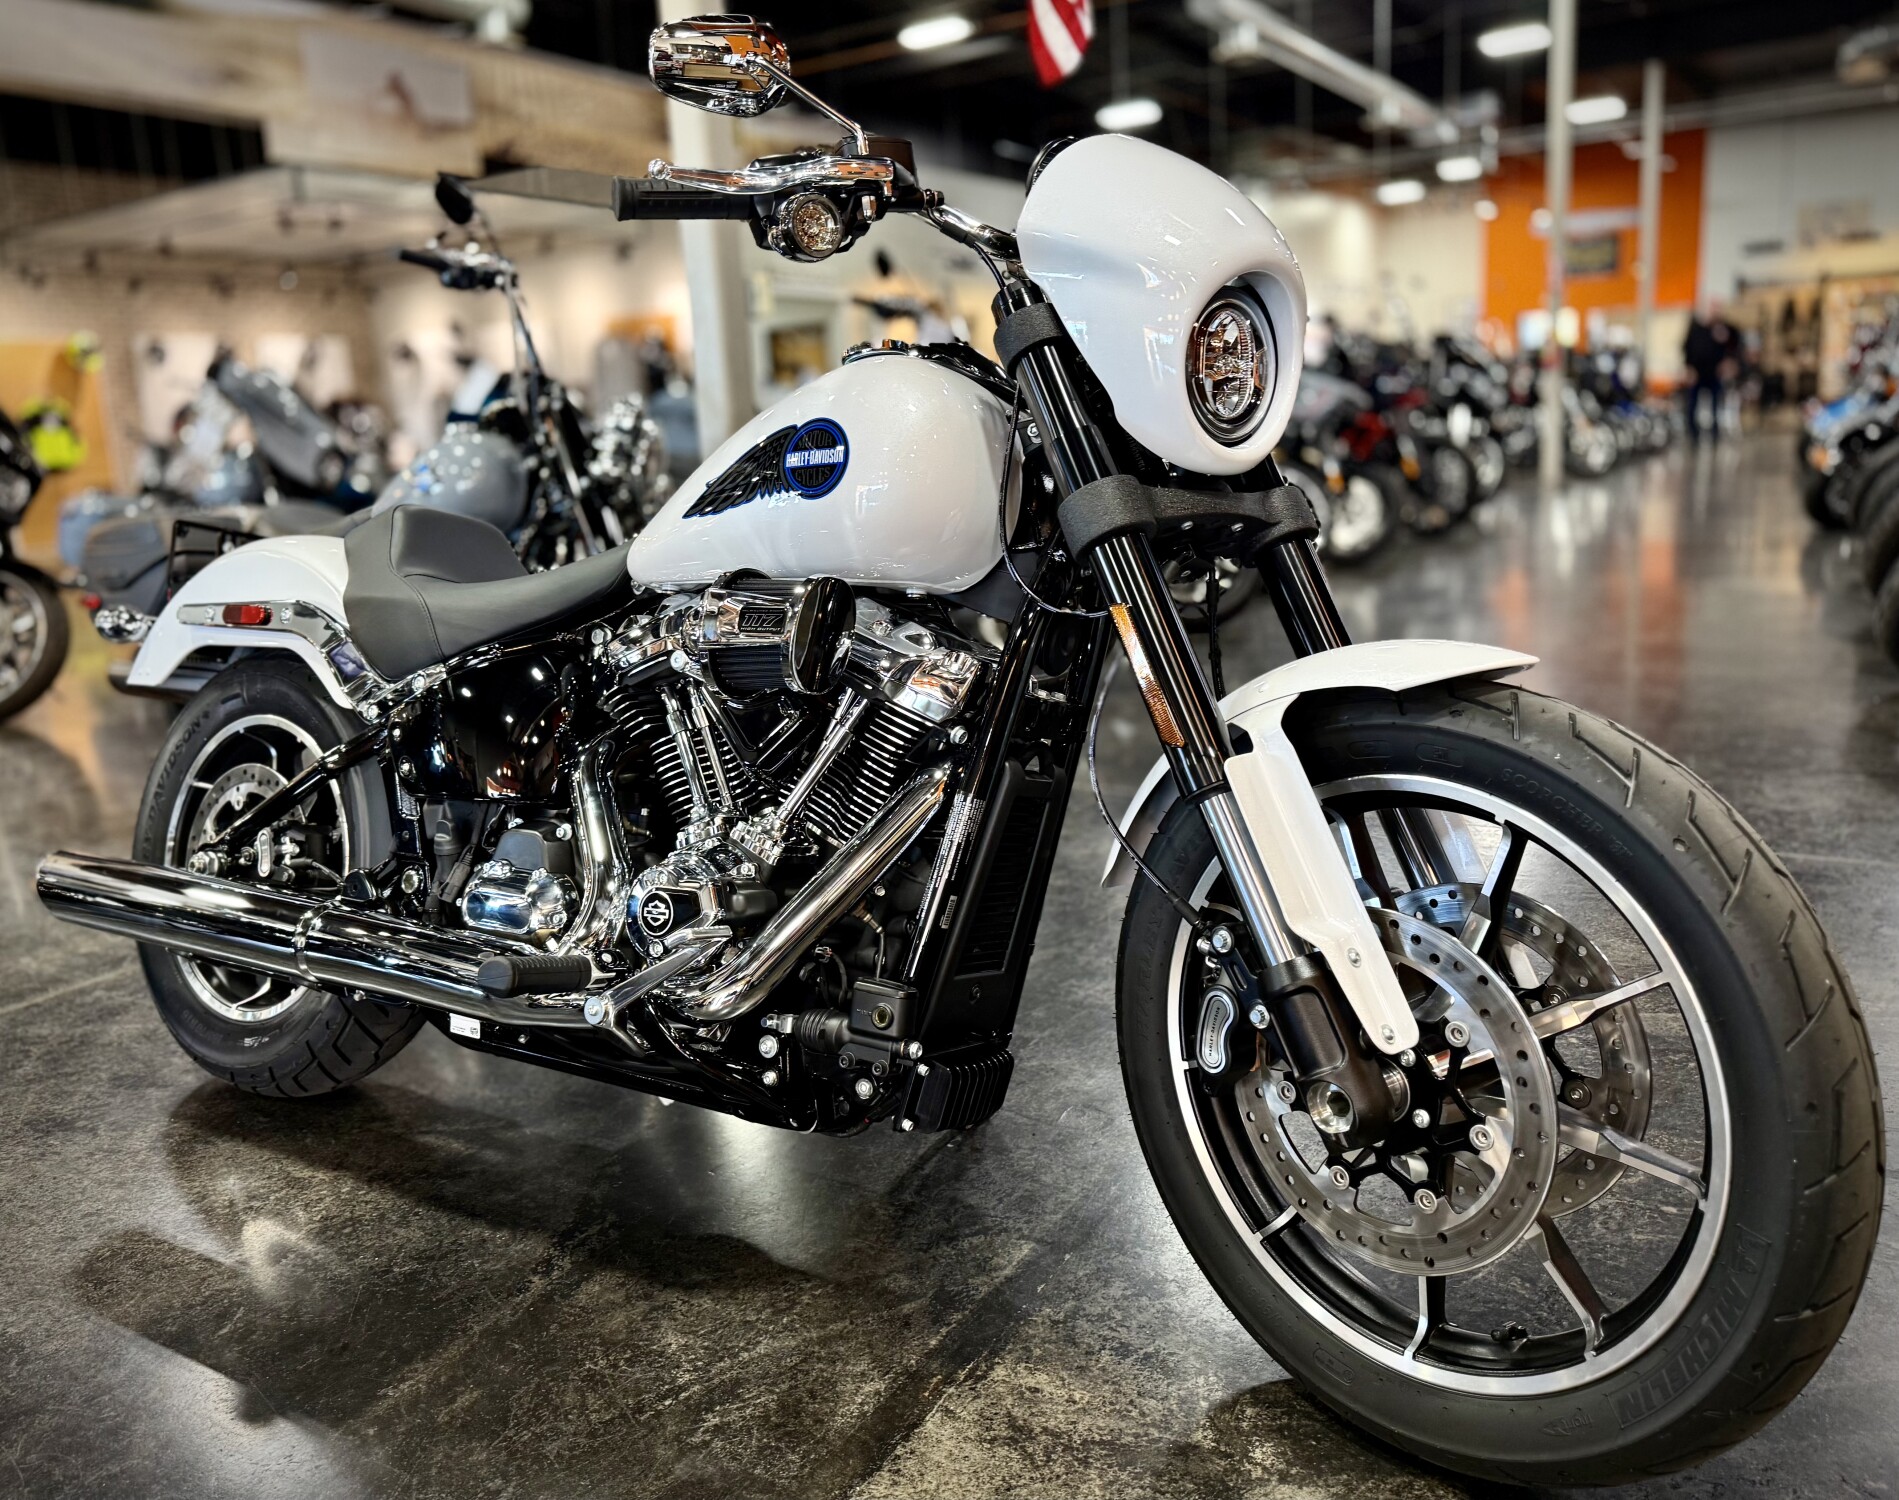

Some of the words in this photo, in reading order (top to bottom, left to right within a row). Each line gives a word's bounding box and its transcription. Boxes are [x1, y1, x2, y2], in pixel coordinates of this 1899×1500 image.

[798, 430, 832, 449] MOTOR
[785, 446, 844, 468] HARLEY-DAVIDSON
[795, 467, 831, 486] CYCLES
[741, 613, 783, 627] 117
[1208, 1006, 1221, 1057] HARLEY-DAVIDSON
[1616, 1276, 1750, 1425] MICHELIN
